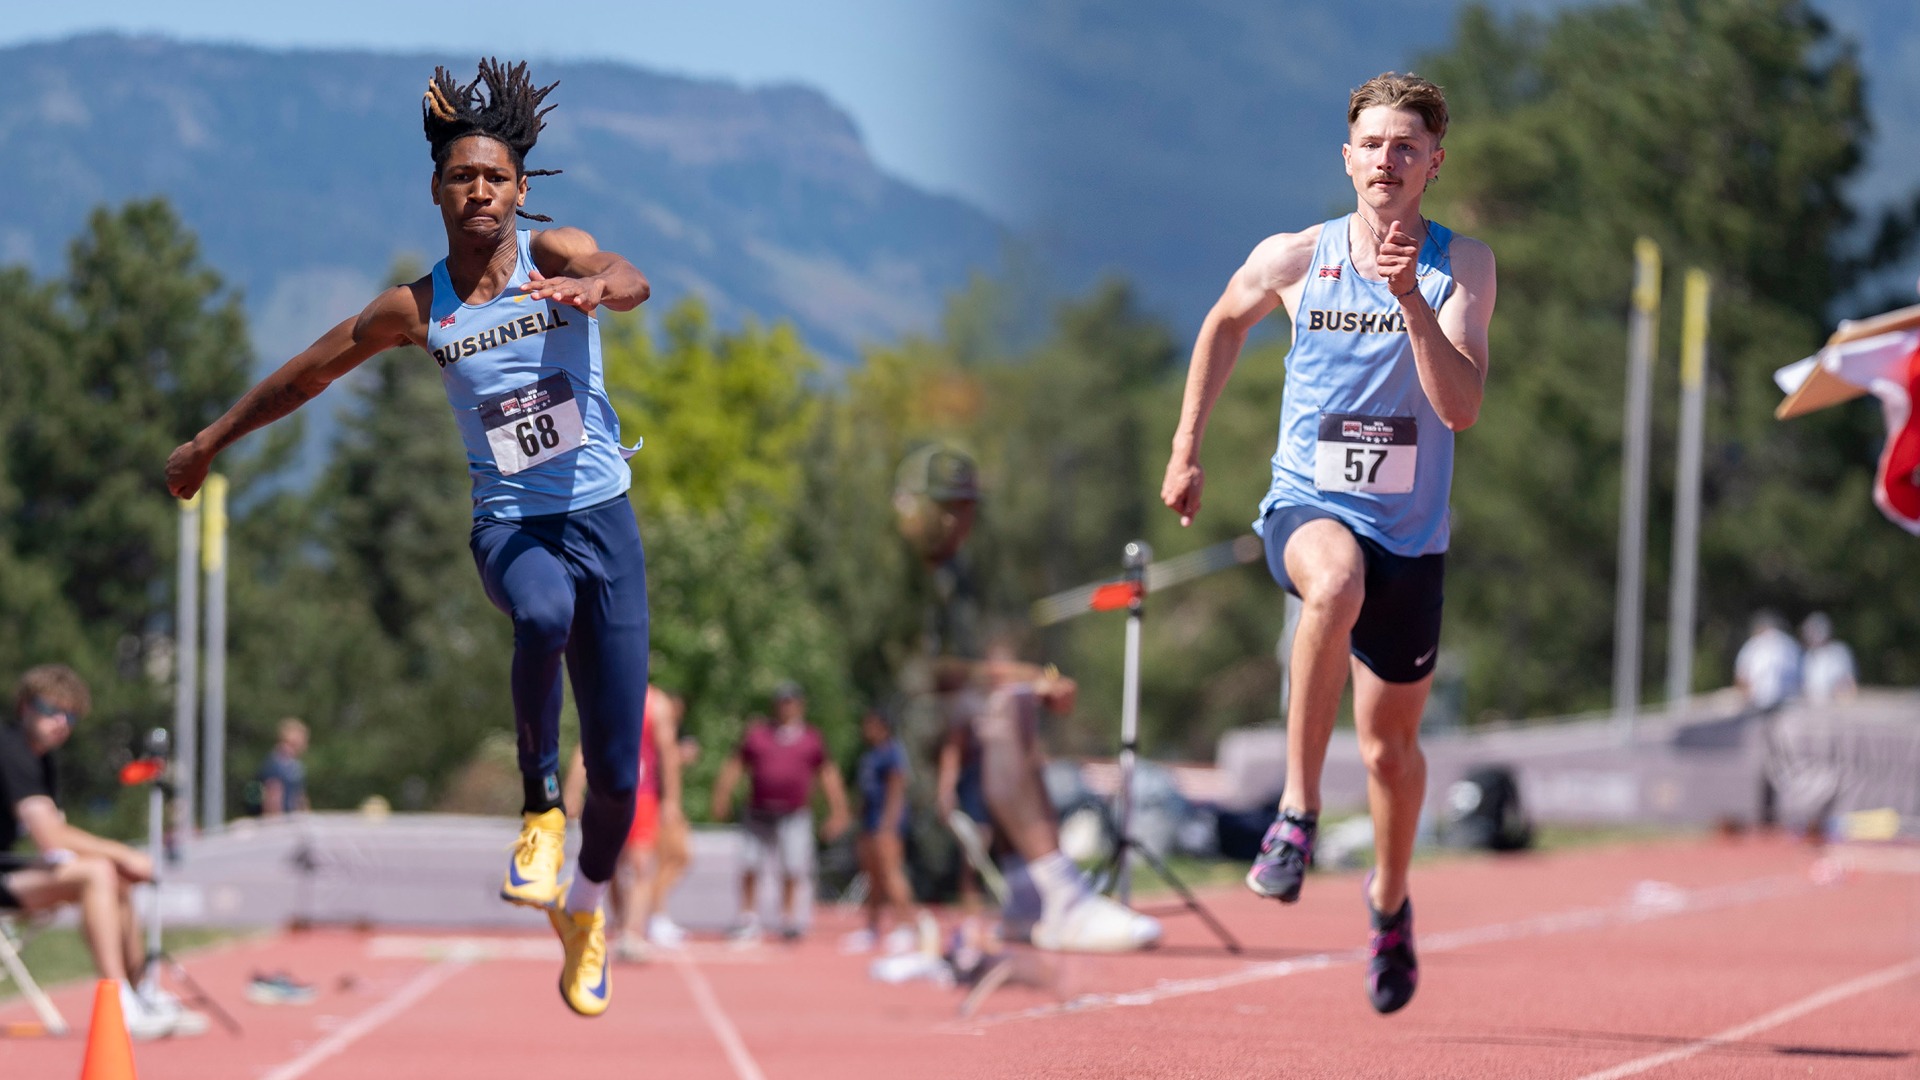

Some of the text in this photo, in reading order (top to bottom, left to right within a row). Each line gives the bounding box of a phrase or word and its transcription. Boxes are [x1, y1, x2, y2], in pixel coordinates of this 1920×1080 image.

[432, 308, 569, 368] BUSHNELL
[1308, 310, 1408, 334] BUSHNE
[515, 413, 560, 457] 68
[1344, 447, 1389, 484] 57
